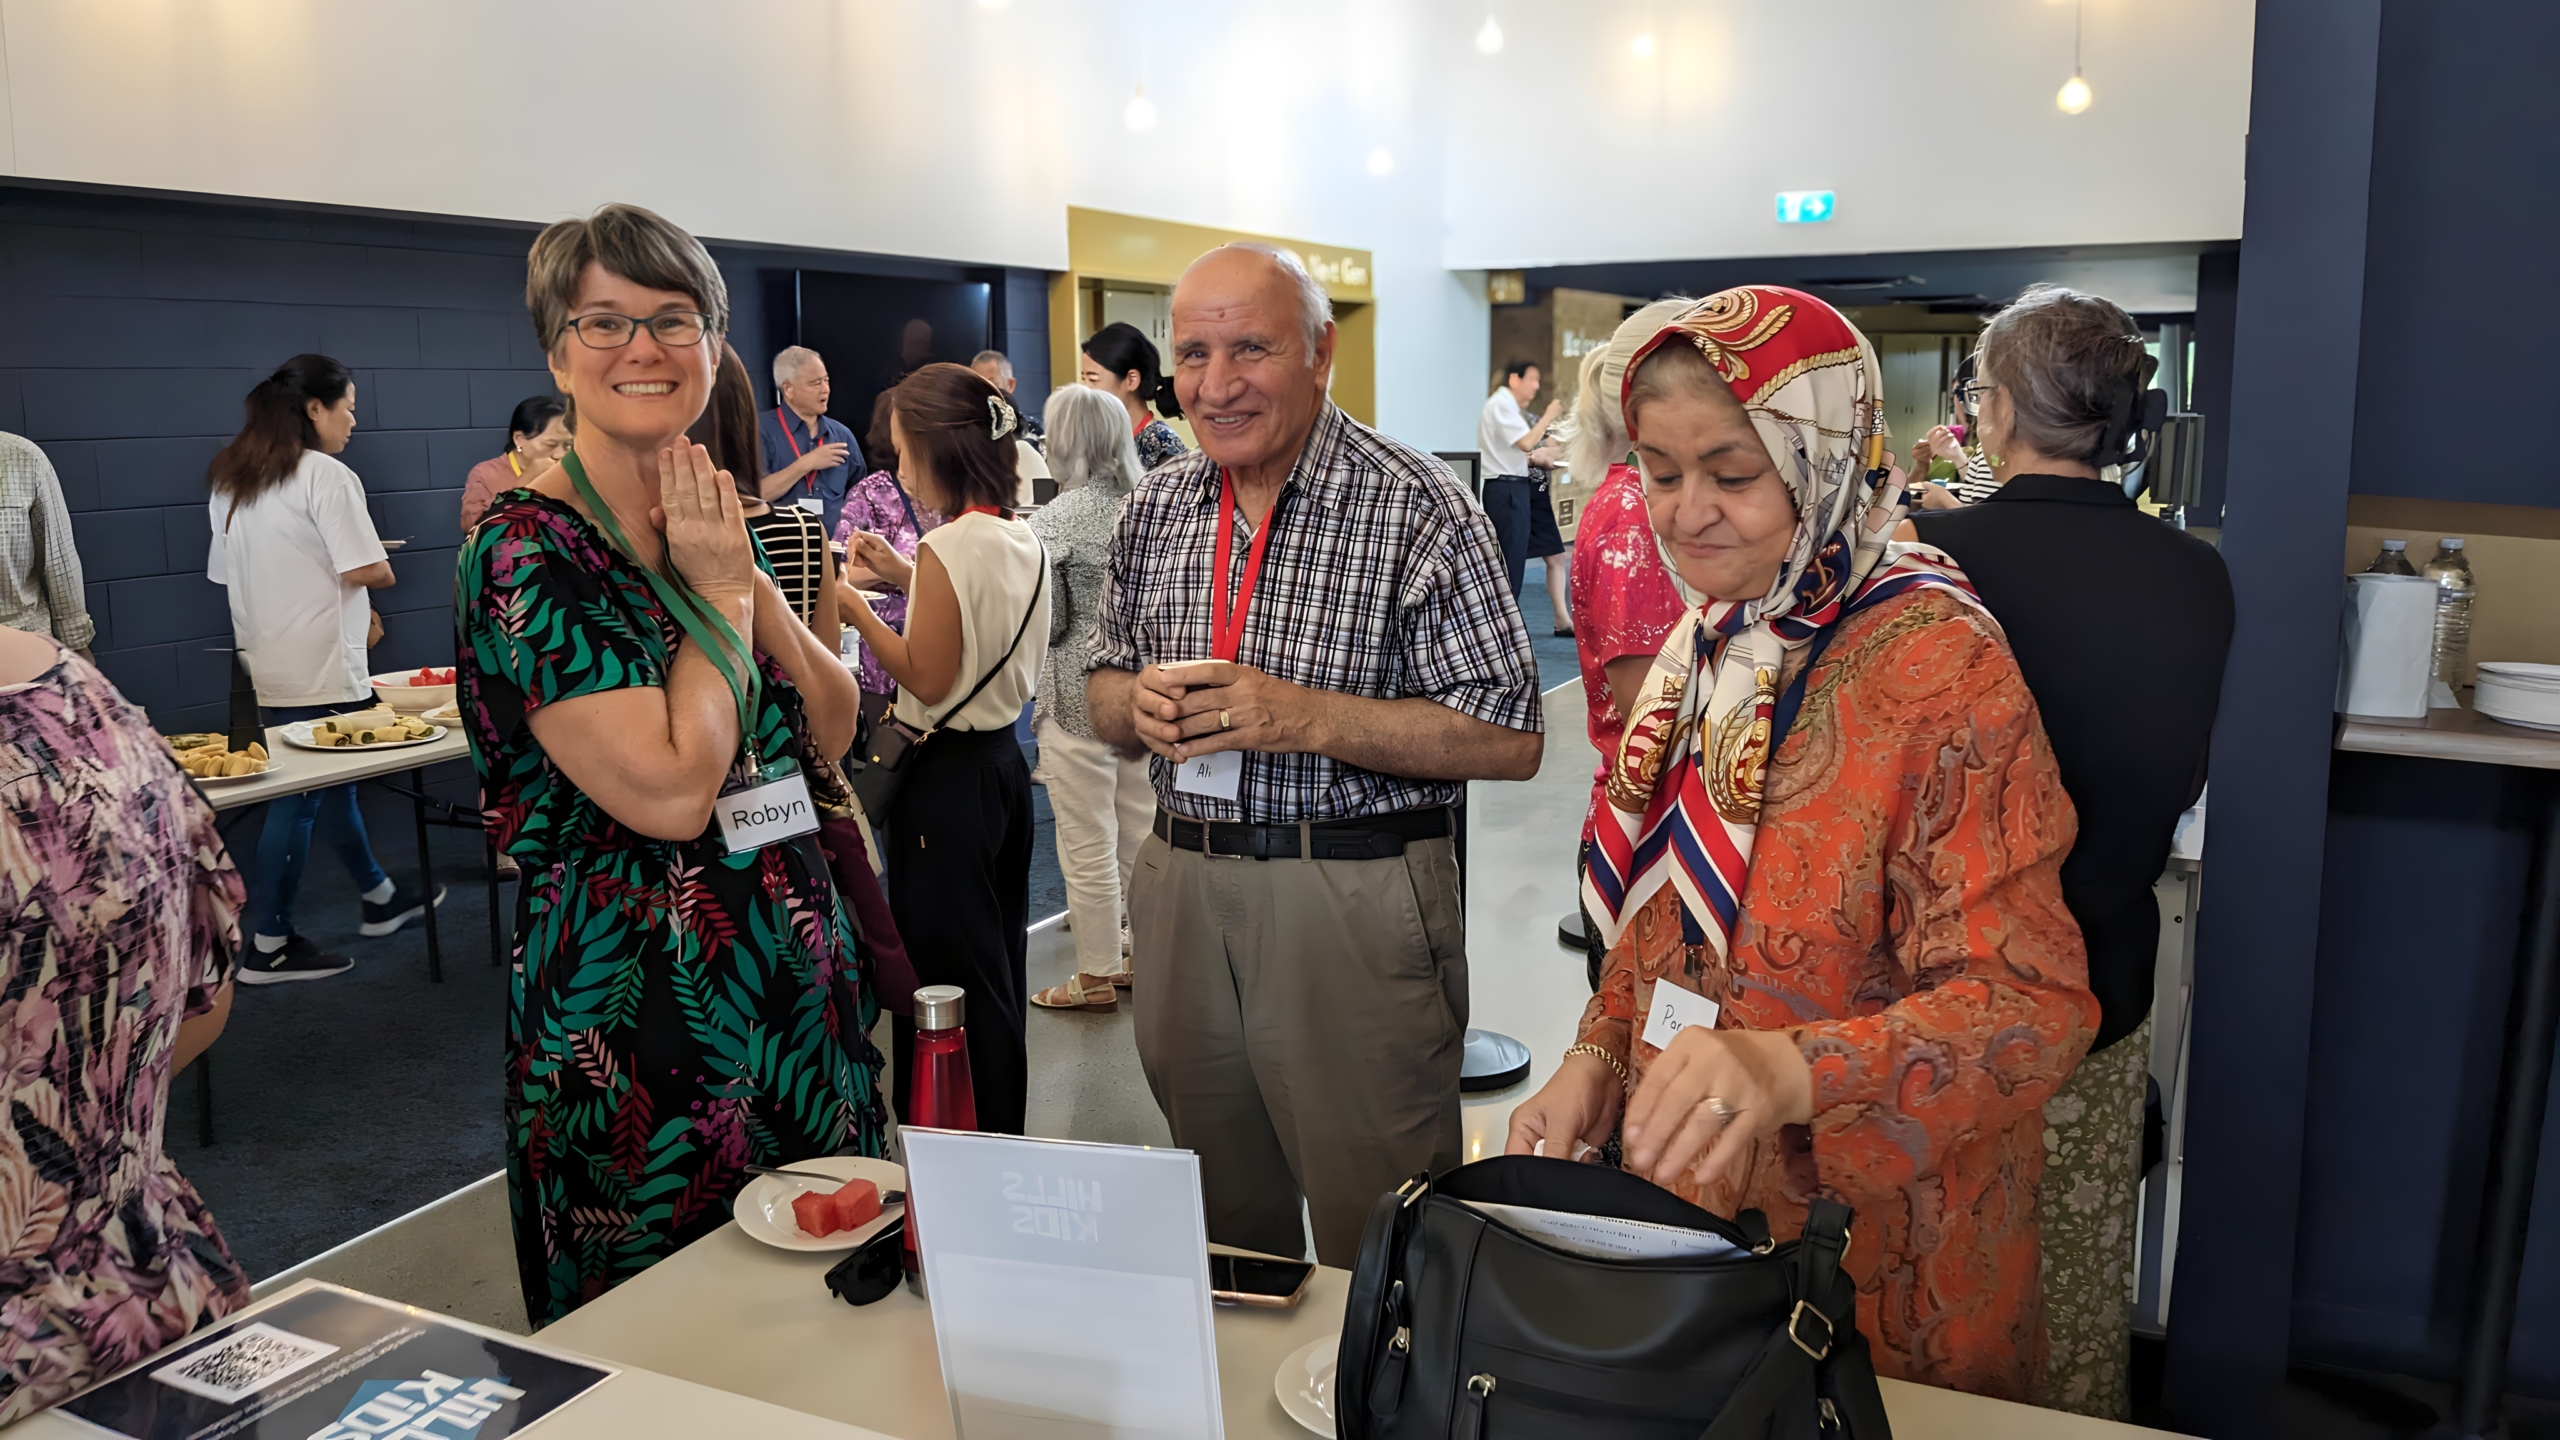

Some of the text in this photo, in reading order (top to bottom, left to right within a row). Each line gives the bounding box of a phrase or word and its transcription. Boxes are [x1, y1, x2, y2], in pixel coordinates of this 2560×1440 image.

[1196, 762, 1212, 778] Ali
[731, 800, 806, 830] Robyn
[1662, 1004, 1687, 1032] Par
